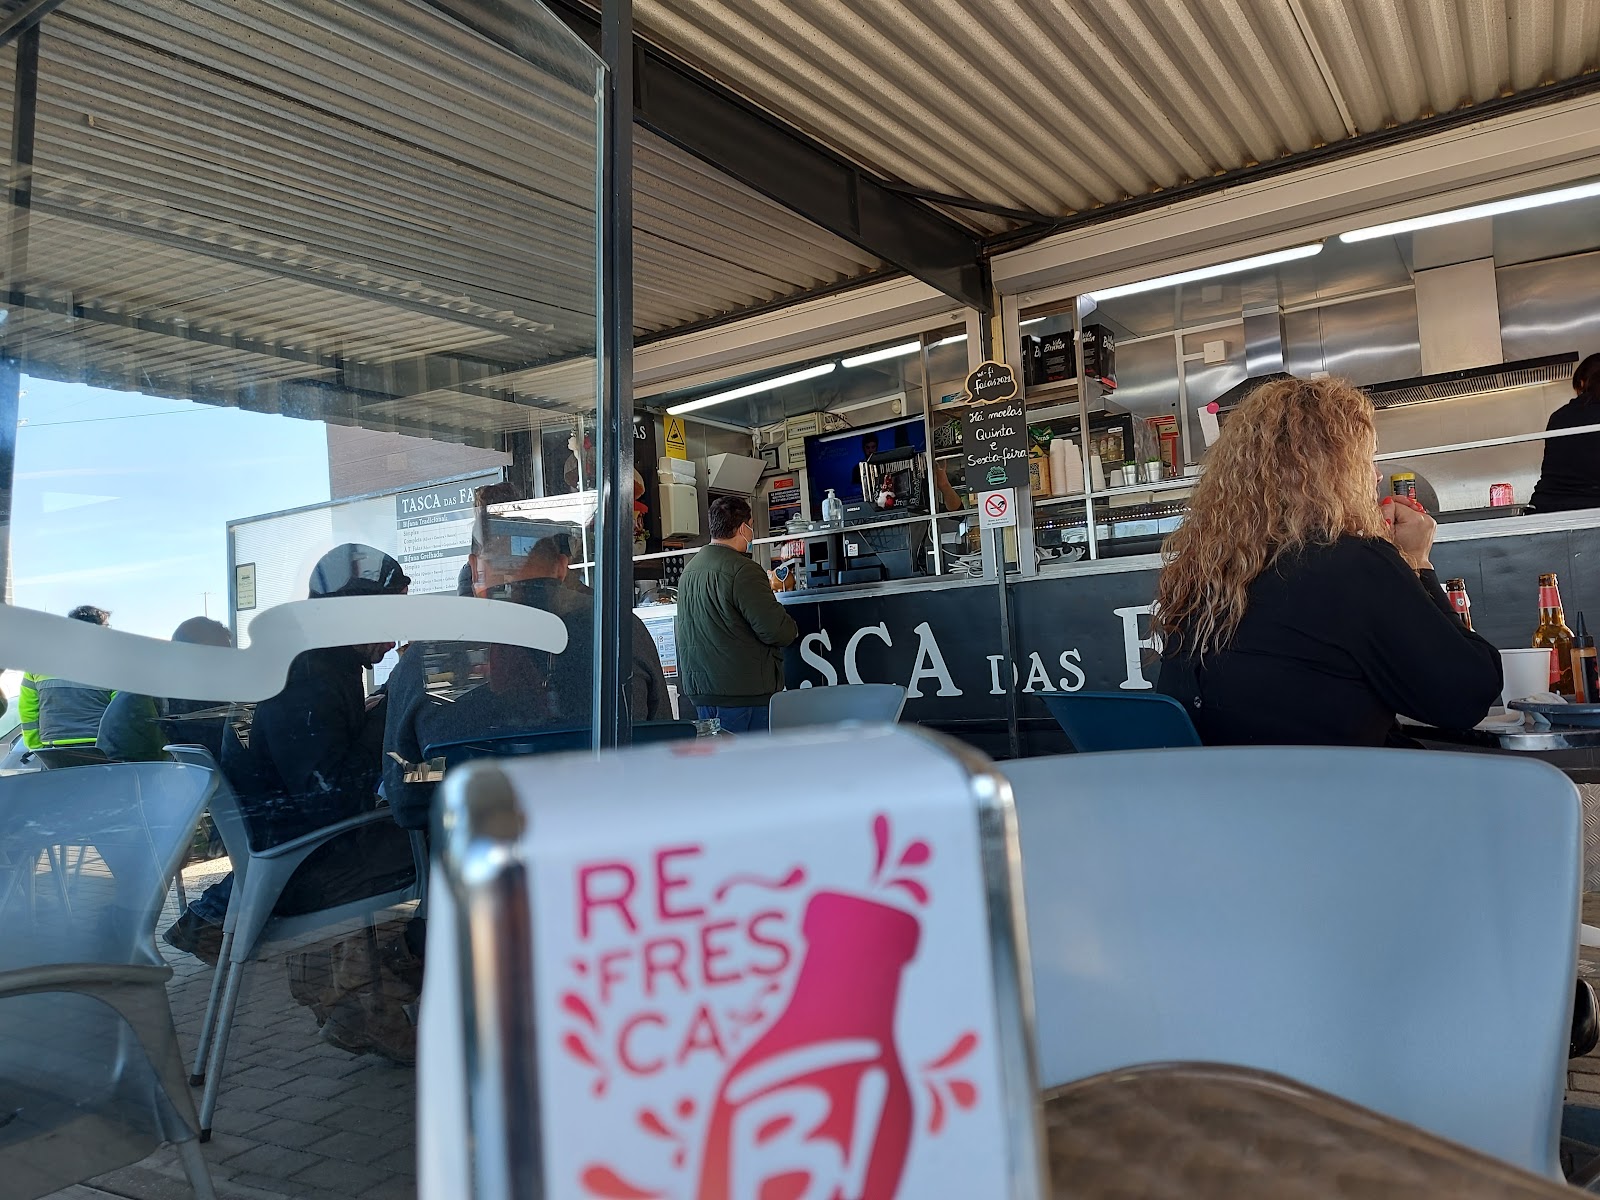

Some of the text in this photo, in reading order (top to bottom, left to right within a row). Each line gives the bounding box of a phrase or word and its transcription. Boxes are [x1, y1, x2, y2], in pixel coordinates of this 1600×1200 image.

[988, 405, 1023, 420] moelas
[633, 424, 646, 440] AS
[975, 424, 1016, 441] Quinta
[967, 447, 1028, 467] Sexta-feira
[989, 441, 998, 451] e
[402, 487, 475, 513] TASCA DAS FA
[799, 621, 963, 698] SCA
[986, 648, 1086, 695] DAS
[575, 842, 707, 940] RE
[597, 911, 792, 1001] FRES
[617, 1007, 727, 1077] CA
